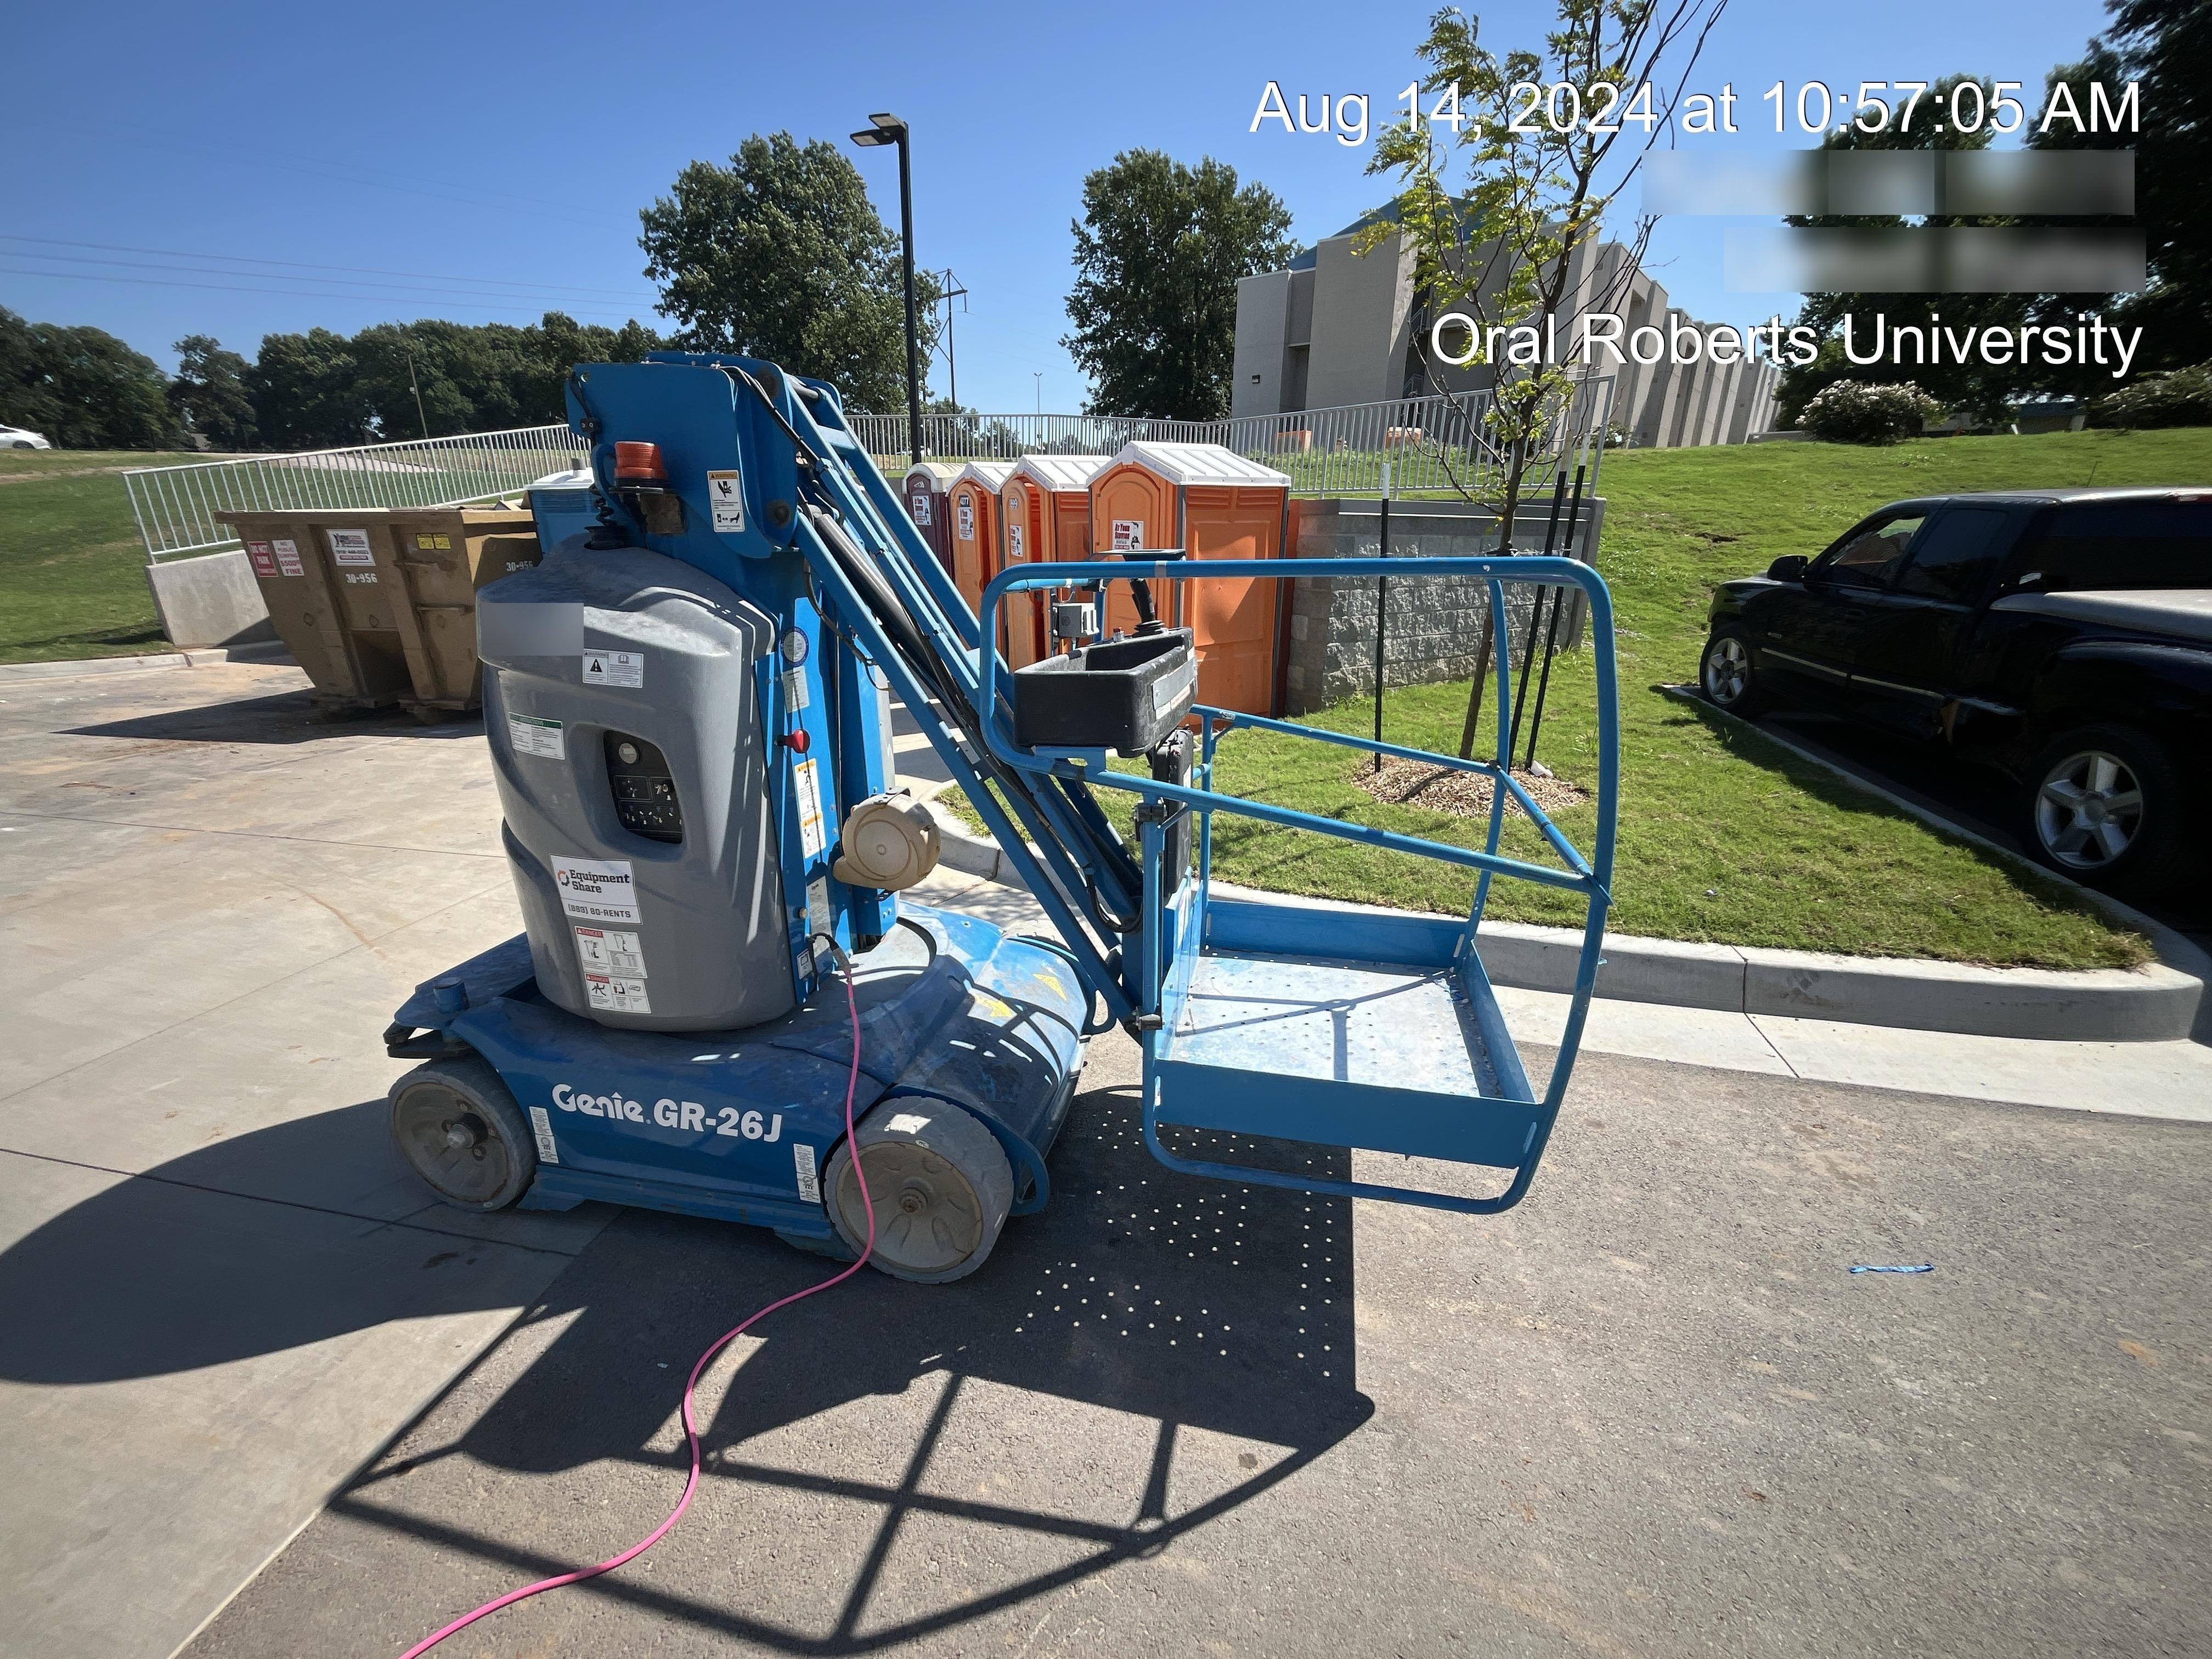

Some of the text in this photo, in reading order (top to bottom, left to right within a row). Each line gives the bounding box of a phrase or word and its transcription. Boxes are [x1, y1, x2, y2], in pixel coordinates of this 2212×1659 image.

[345, 573, 377, 583] 30-956
[569, 869, 630, 883] Equipment
[572, 881, 602, 893] Share
[590, 907, 631, 918] 80-RENTS
[552, 1083, 783, 1143] Genie GR-26J
